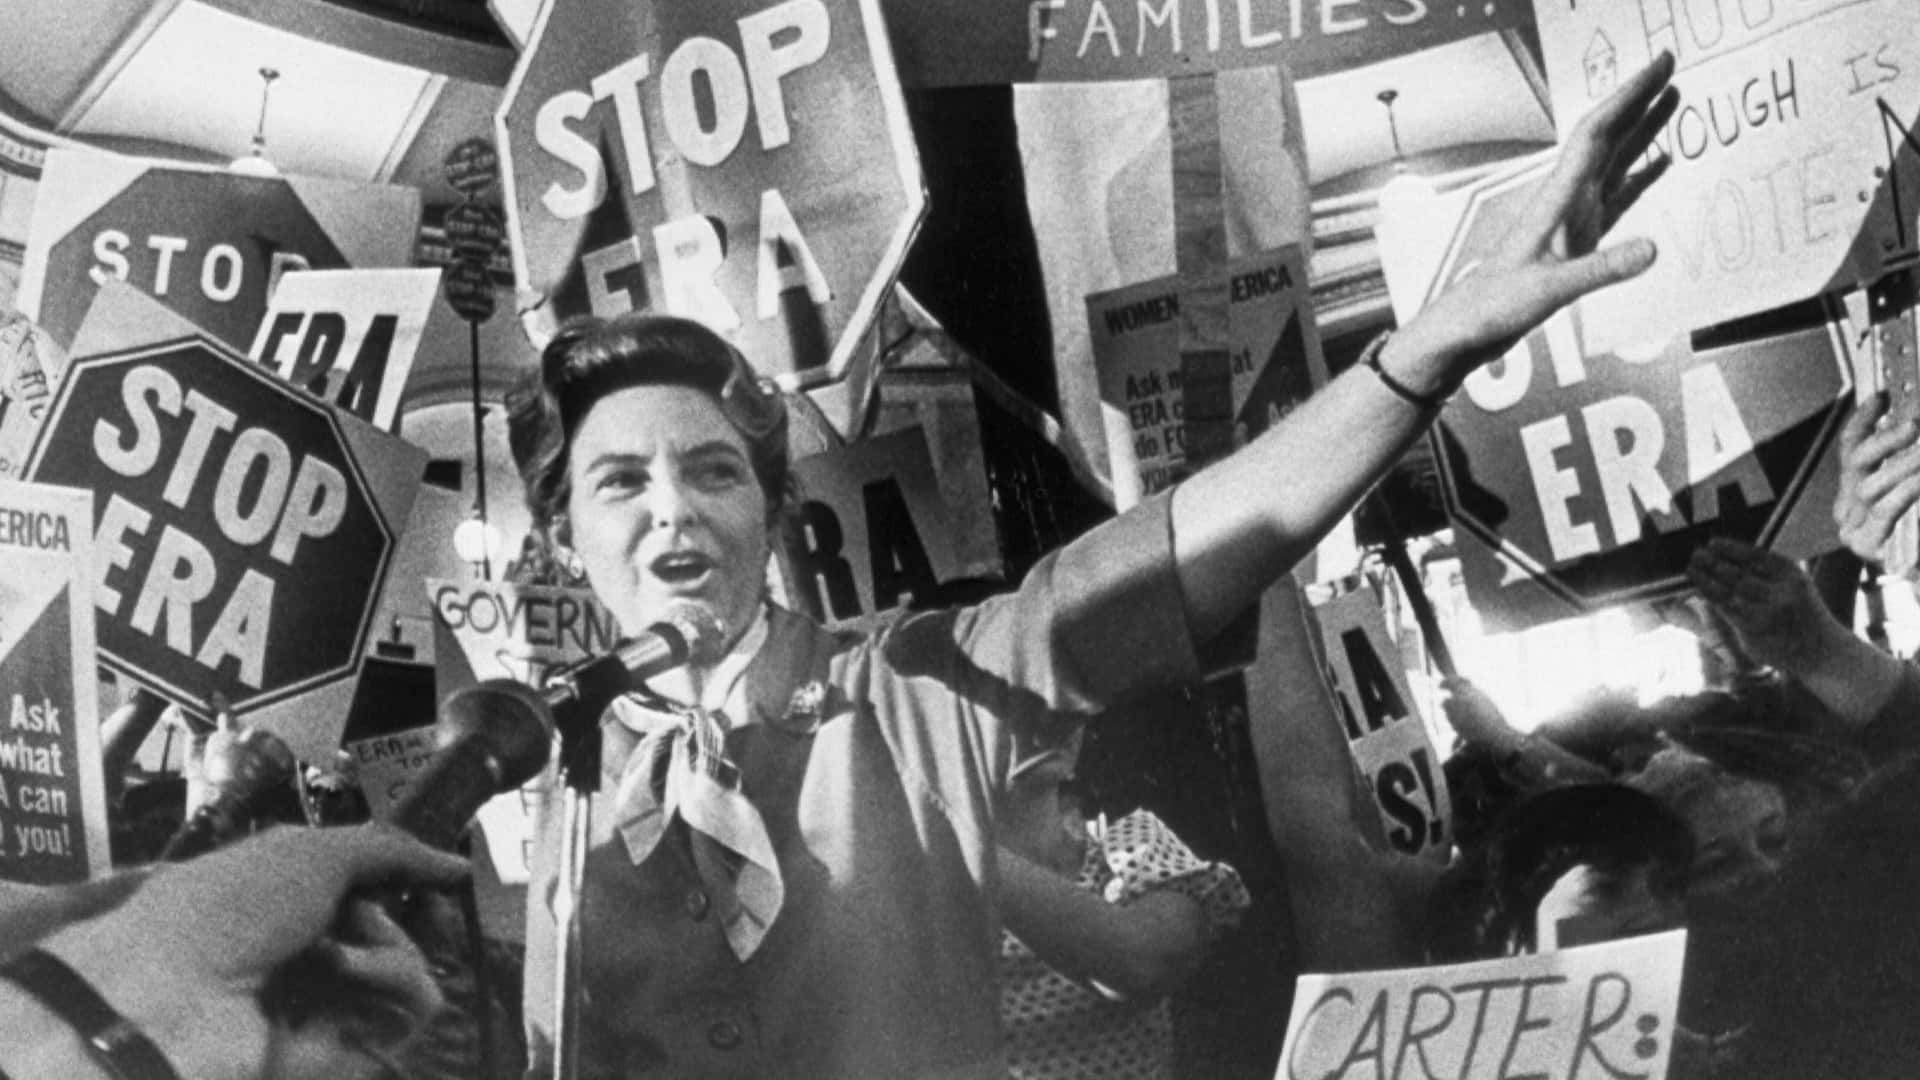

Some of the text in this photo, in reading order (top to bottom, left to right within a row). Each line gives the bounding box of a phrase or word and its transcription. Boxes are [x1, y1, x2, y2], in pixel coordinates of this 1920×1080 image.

[1845, 44, 1900, 95] IS
[536, 0, 831, 219] STOP
[583, 188, 831, 336] ERA
[1103, 292, 1180, 337] WOMEN
[257, 312, 398, 425] ERA
[1129, 399, 1169, 431] ERA
[94, 365, 348, 566] STOP
[1520, 361, 1775, 562] ERA
[97, 493, 275, 690] ERA
[436, 586, 620, 656] GOVERN
[10, 693, 62, 736] Ask
[0, 737, 64, 777] what
[19, 786, 67, 816] can
[16, 824, 72, 858] you!
[1289, 972, 1659, 1080] CARTER:
